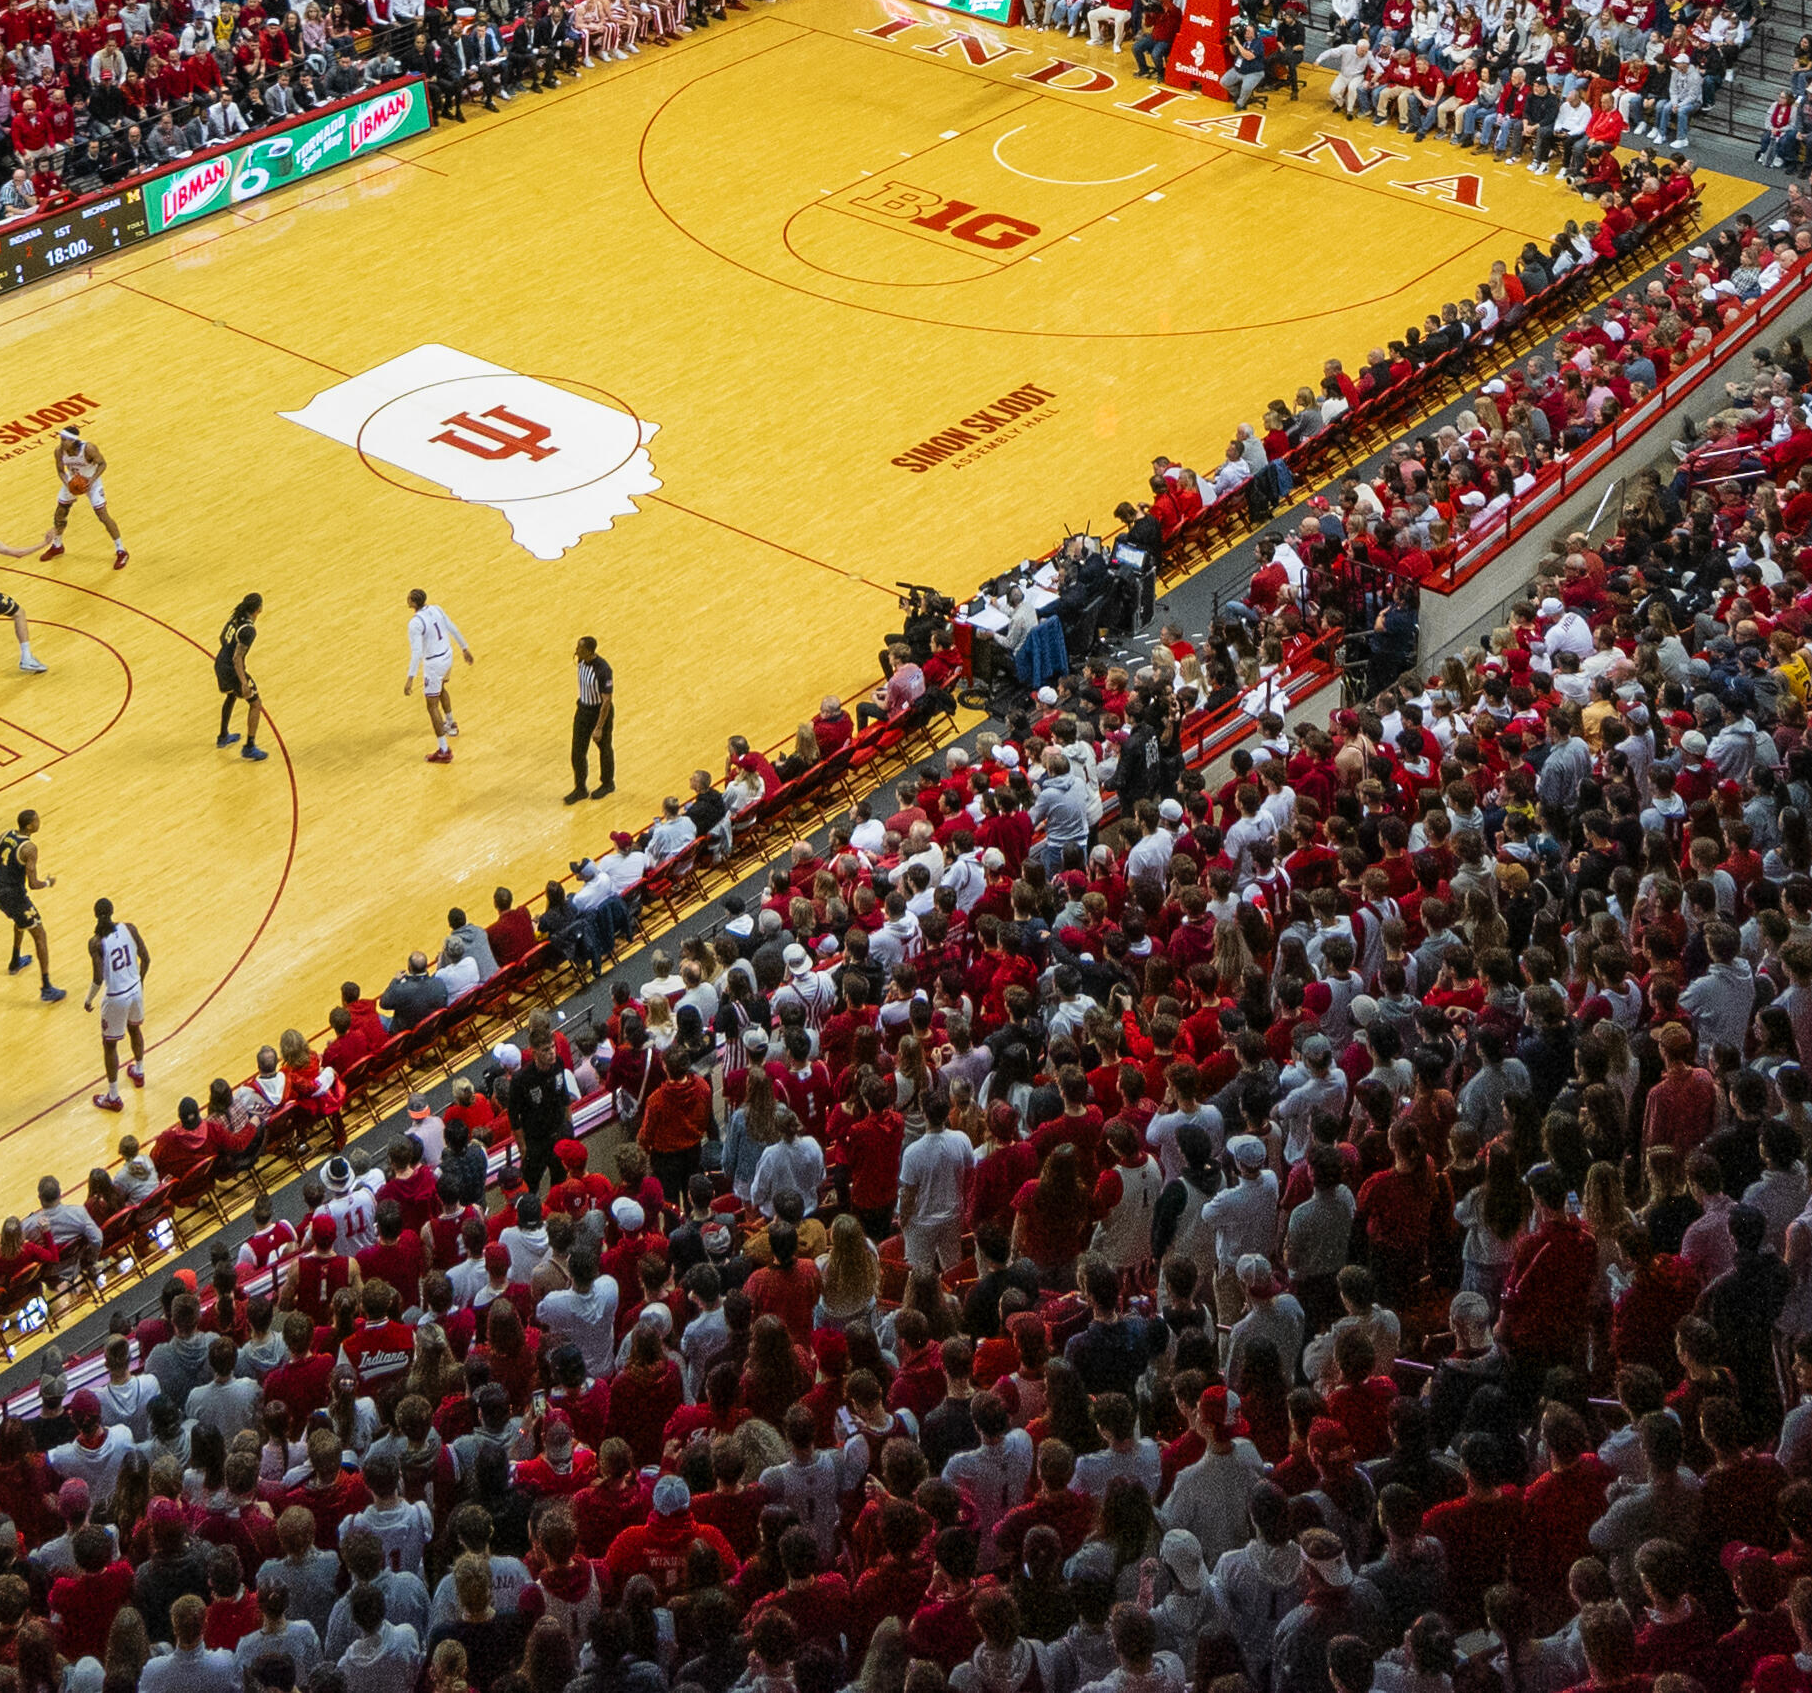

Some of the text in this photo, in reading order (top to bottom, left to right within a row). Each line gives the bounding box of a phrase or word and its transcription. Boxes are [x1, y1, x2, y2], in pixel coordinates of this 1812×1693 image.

[1189, 14, 1213, 28] meijer
[1175, 61, 1220, 82] Smithville
[349, 91, 406, 155] LIBMAN
[853, 12, 1489, 213] INDIANA
[294, 114, 347, 165] TORNADO
[162, 160, 225, 226] LIBMAN
[9, 228, 43, 246] INDIANA
[54, 225, 71, 238] 1ST
[82, 198, 121, 219] MICHIGAN
[126, 190, 141, 204] M
[127, 220, 144, 230] FOULS
[26, 245, 33, 258] 2
[45, 238, 88, 267] 18:00
[50, 417, 95, 439] HLL
[428, 404, 560, 465] IU
[891, 383, 1057, 473] SIMON SKJODT
[951, 408, 1060, 470] ASSEMBLY HALL
[433, 621, 443, 641] 1
[110, 943, 133, 972] 21
[343, 1212, 368, 1238] 11
[359, 1348, 410, 1370] Indiana
